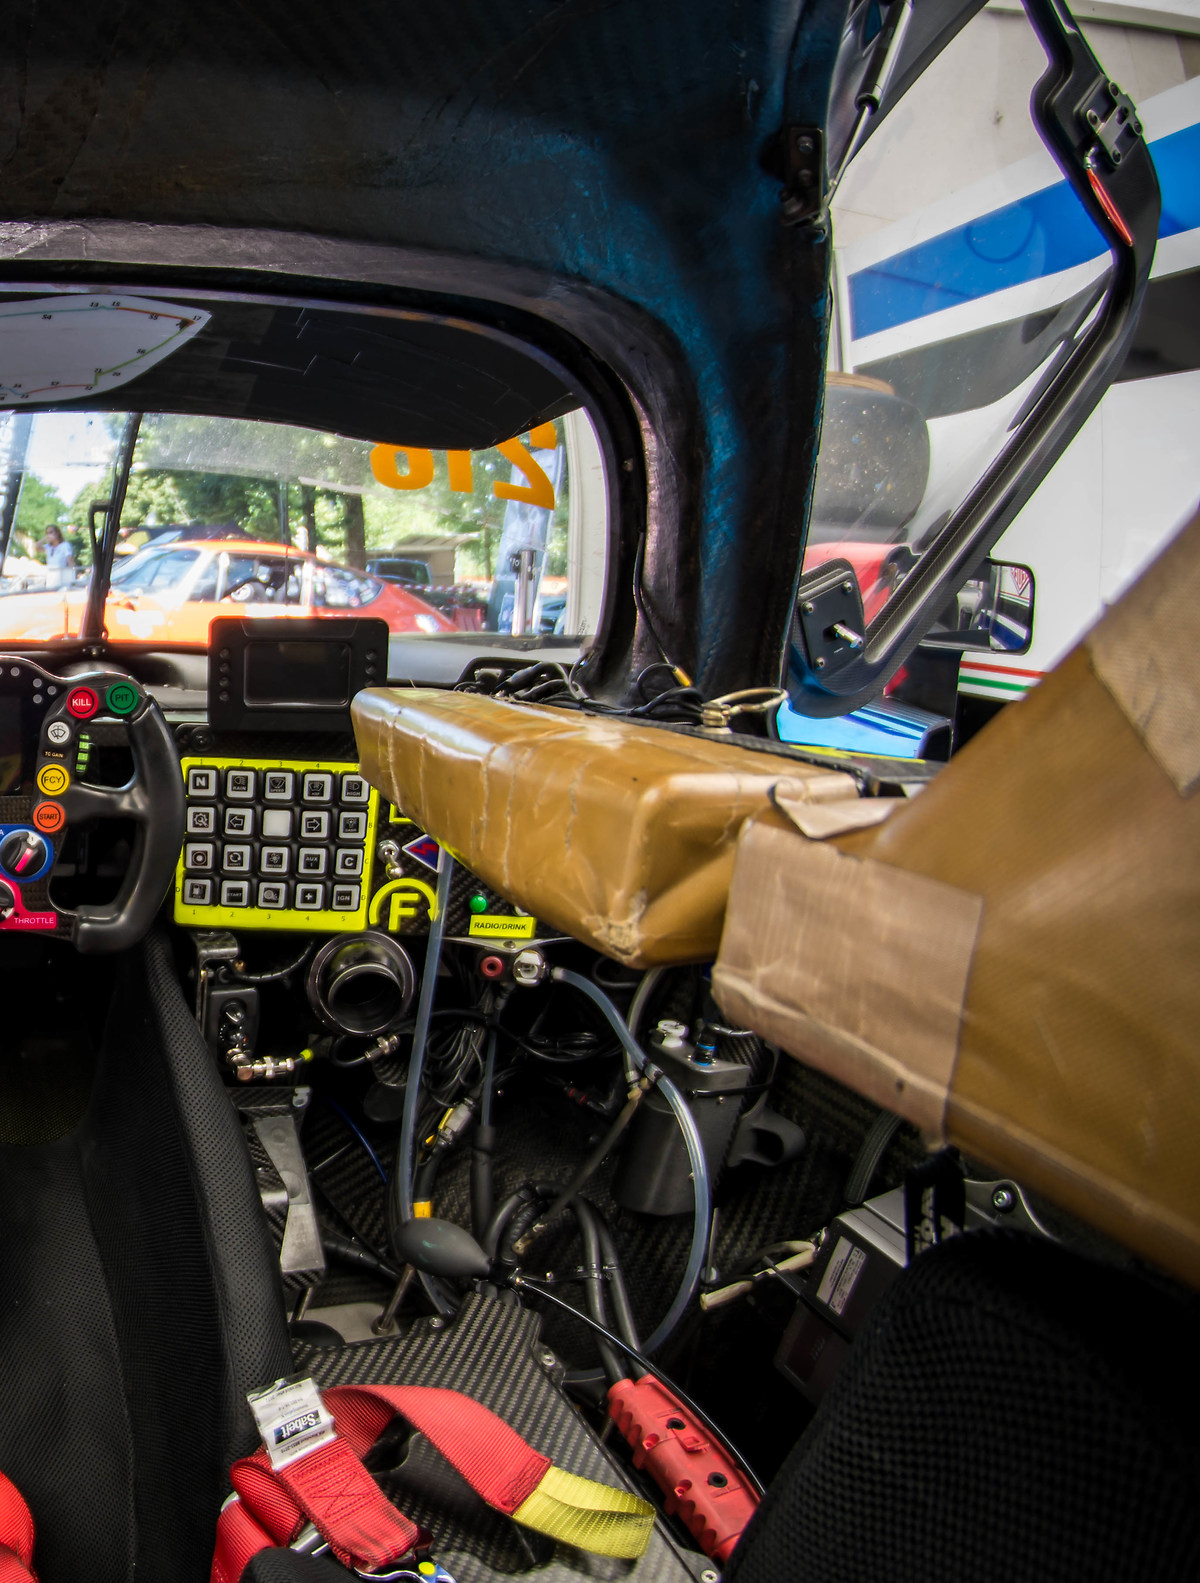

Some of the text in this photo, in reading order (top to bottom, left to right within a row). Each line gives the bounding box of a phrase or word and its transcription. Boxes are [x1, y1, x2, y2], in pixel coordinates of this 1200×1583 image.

[72, 698, 91, 706] KILL
[114, 693, 129, 702] PIT
[44, 776, 62, 784] FCY
[196, 776, 206, 787] N
[344, 857, 354, 867] C
[388, 893, 421, 932] F
[474, 922, 527, 932] RADIO/DRINK
[281, 1413, 317, 1439] Sabelt
